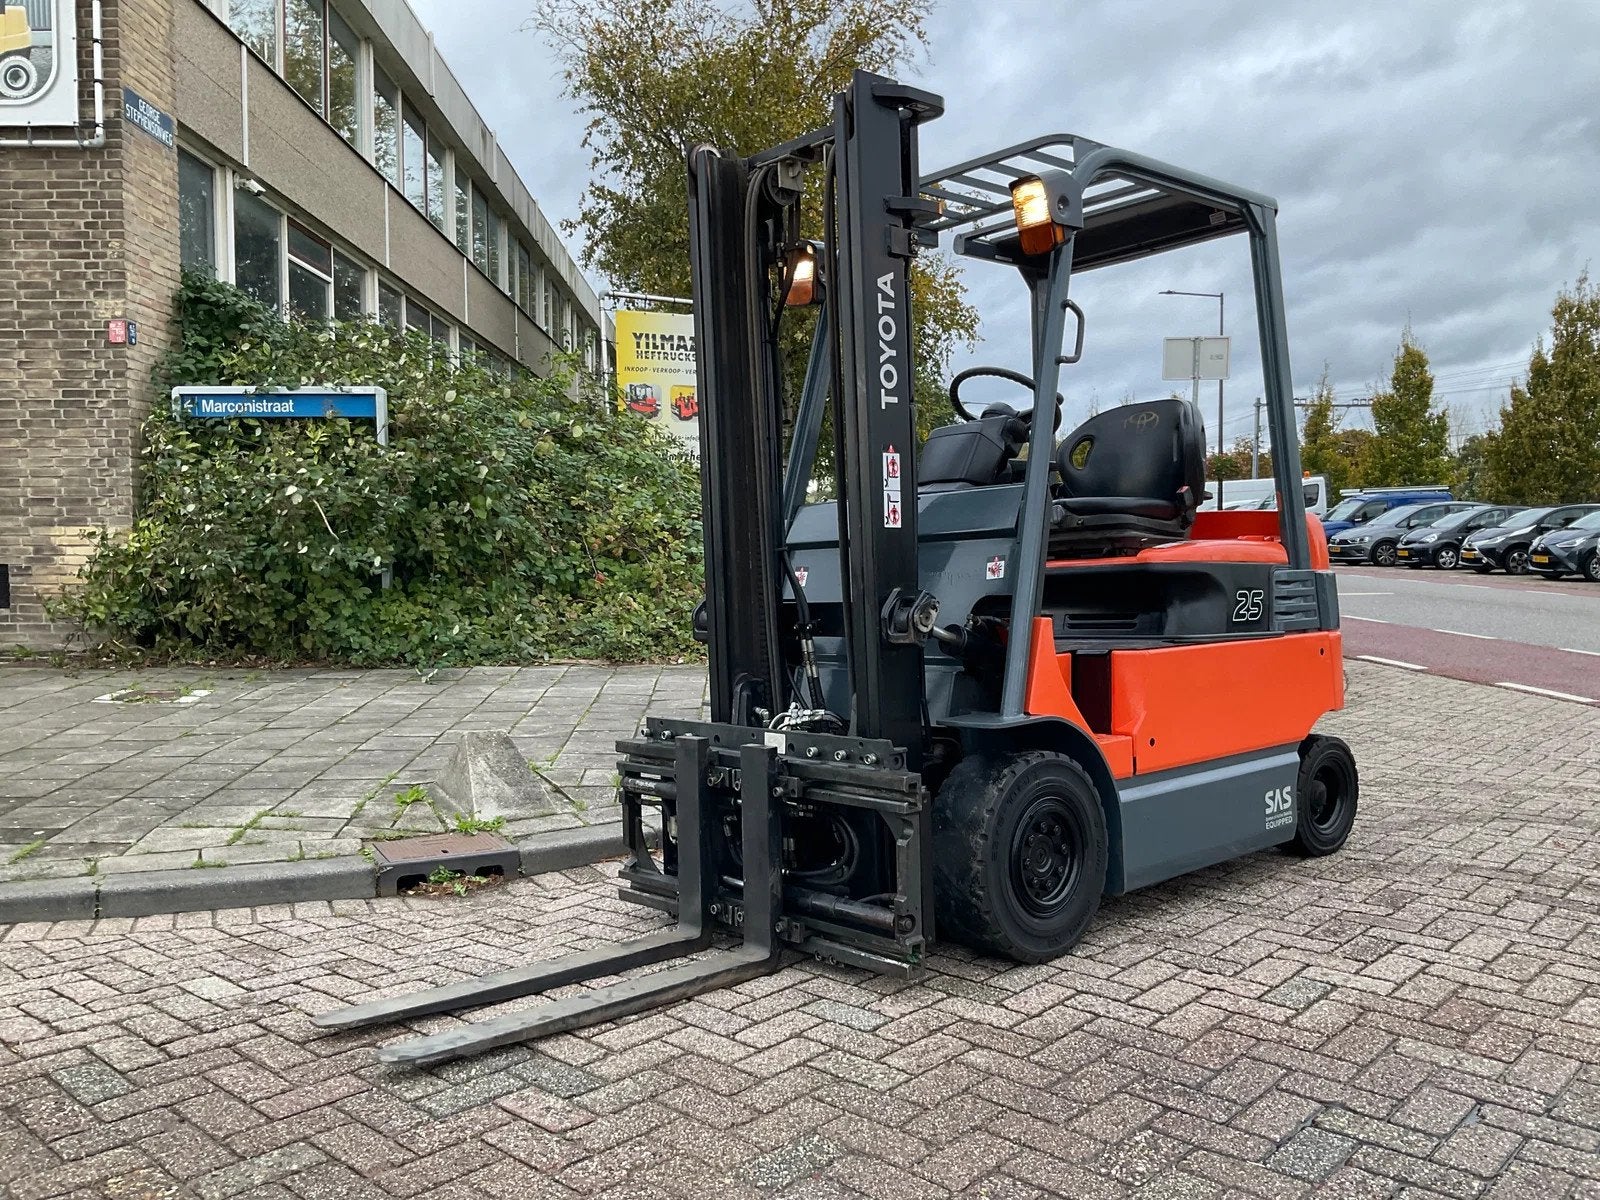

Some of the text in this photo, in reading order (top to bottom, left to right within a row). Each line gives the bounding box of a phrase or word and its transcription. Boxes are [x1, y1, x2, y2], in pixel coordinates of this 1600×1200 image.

[125, 103, 173, 146] STEPHENSONWEG
[138, 98, 161, 125] GEORGE
[877, 271, 899, 410] TOYOTA
[201, 399, 295, 413] Marconistraat
[1232, 589, 1264, 622] 25
[1264, 785, 1292, 815] SAS
[1265, 815, 1293, 830] EQUIPPED
